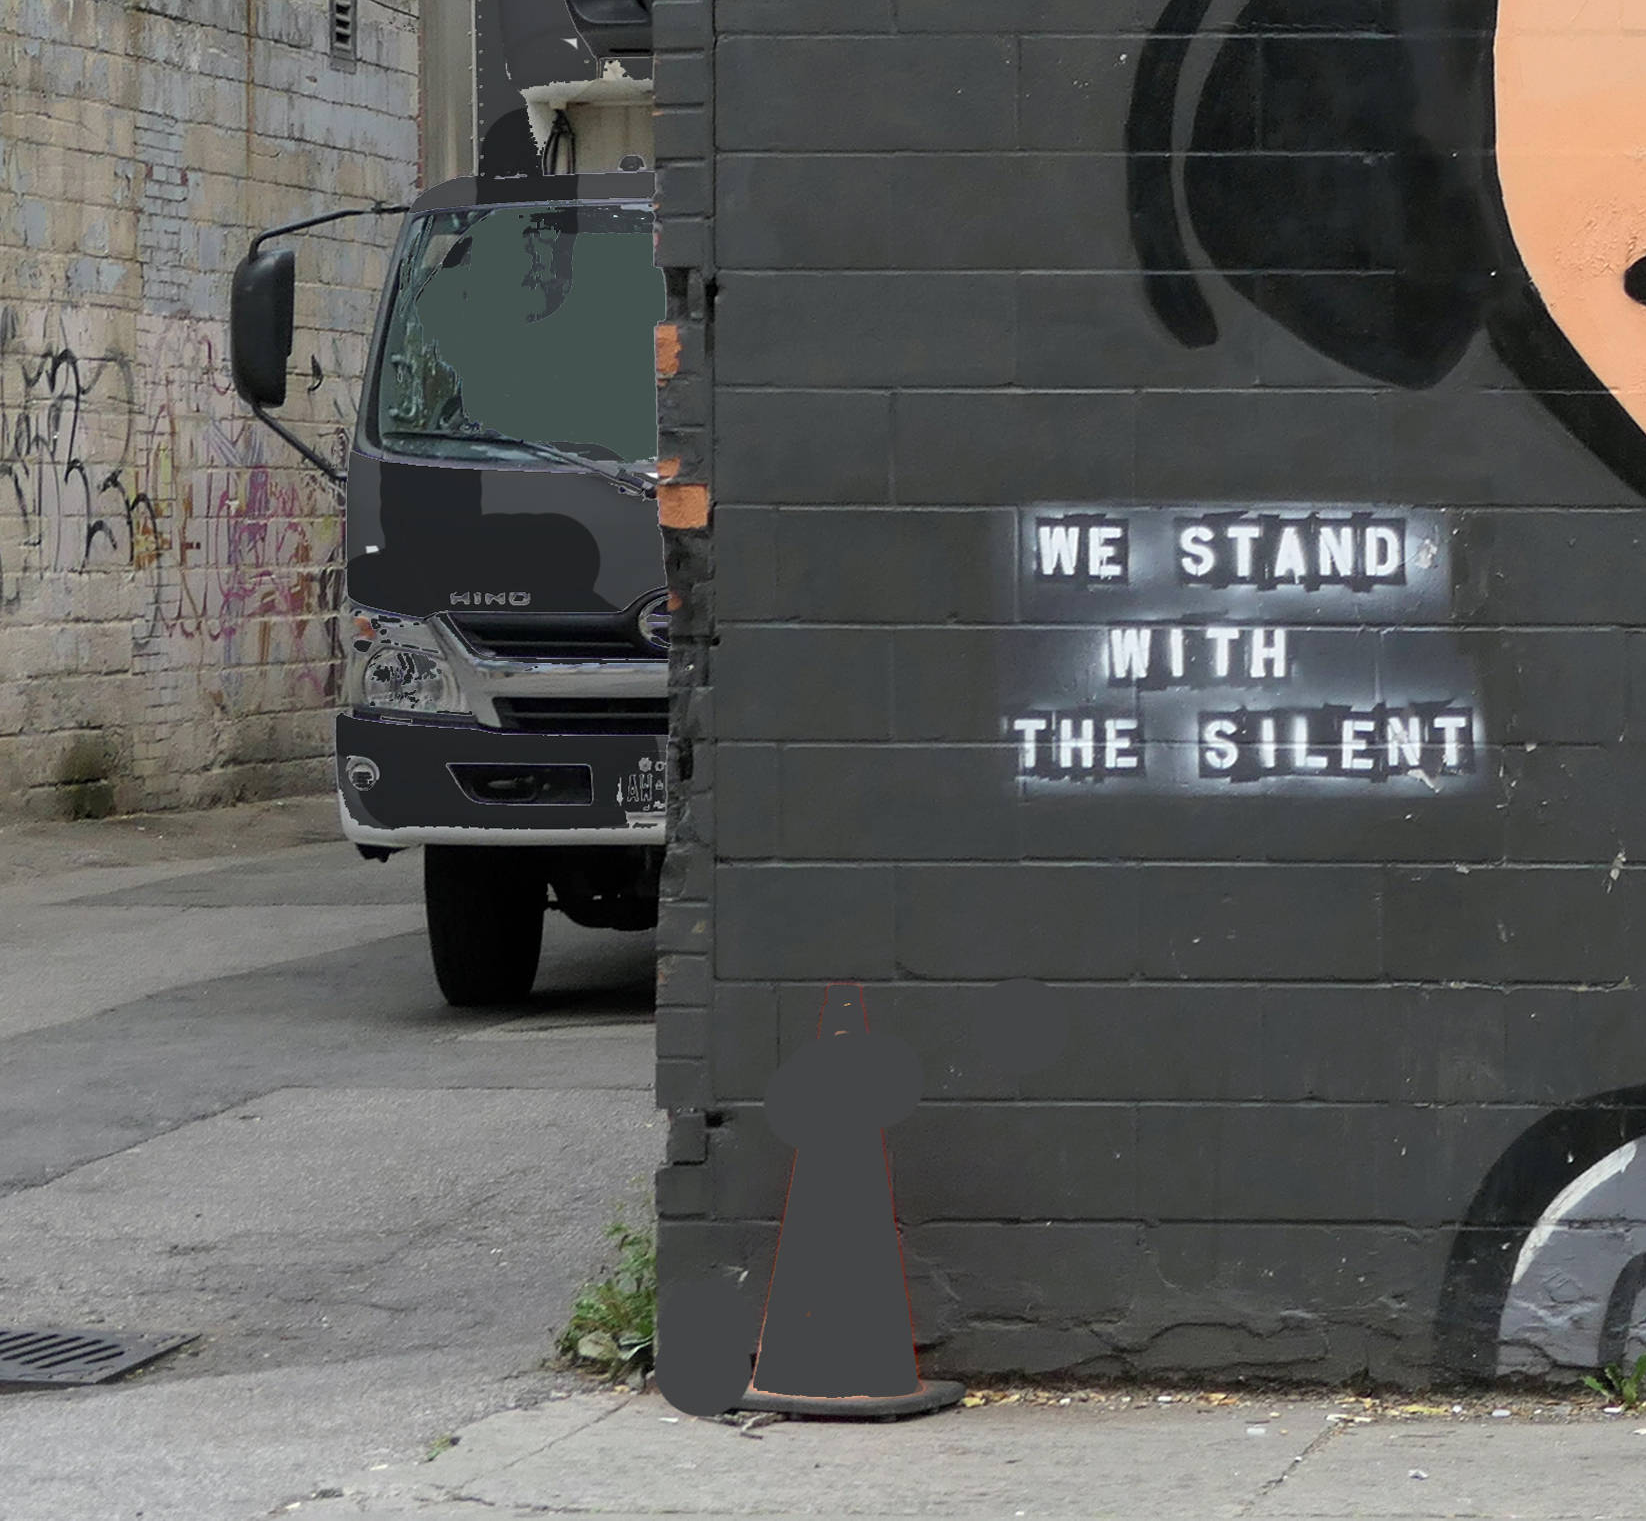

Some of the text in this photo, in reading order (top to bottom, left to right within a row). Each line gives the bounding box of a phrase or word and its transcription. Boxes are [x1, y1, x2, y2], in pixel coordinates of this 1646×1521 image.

[1038, 526, 1402, 578] WE STAND
[450, 590, 531, 606] HINO
[1108, 628, 1288, 679] WITH
[1012, 715, 1469, 771] THE SILENT
